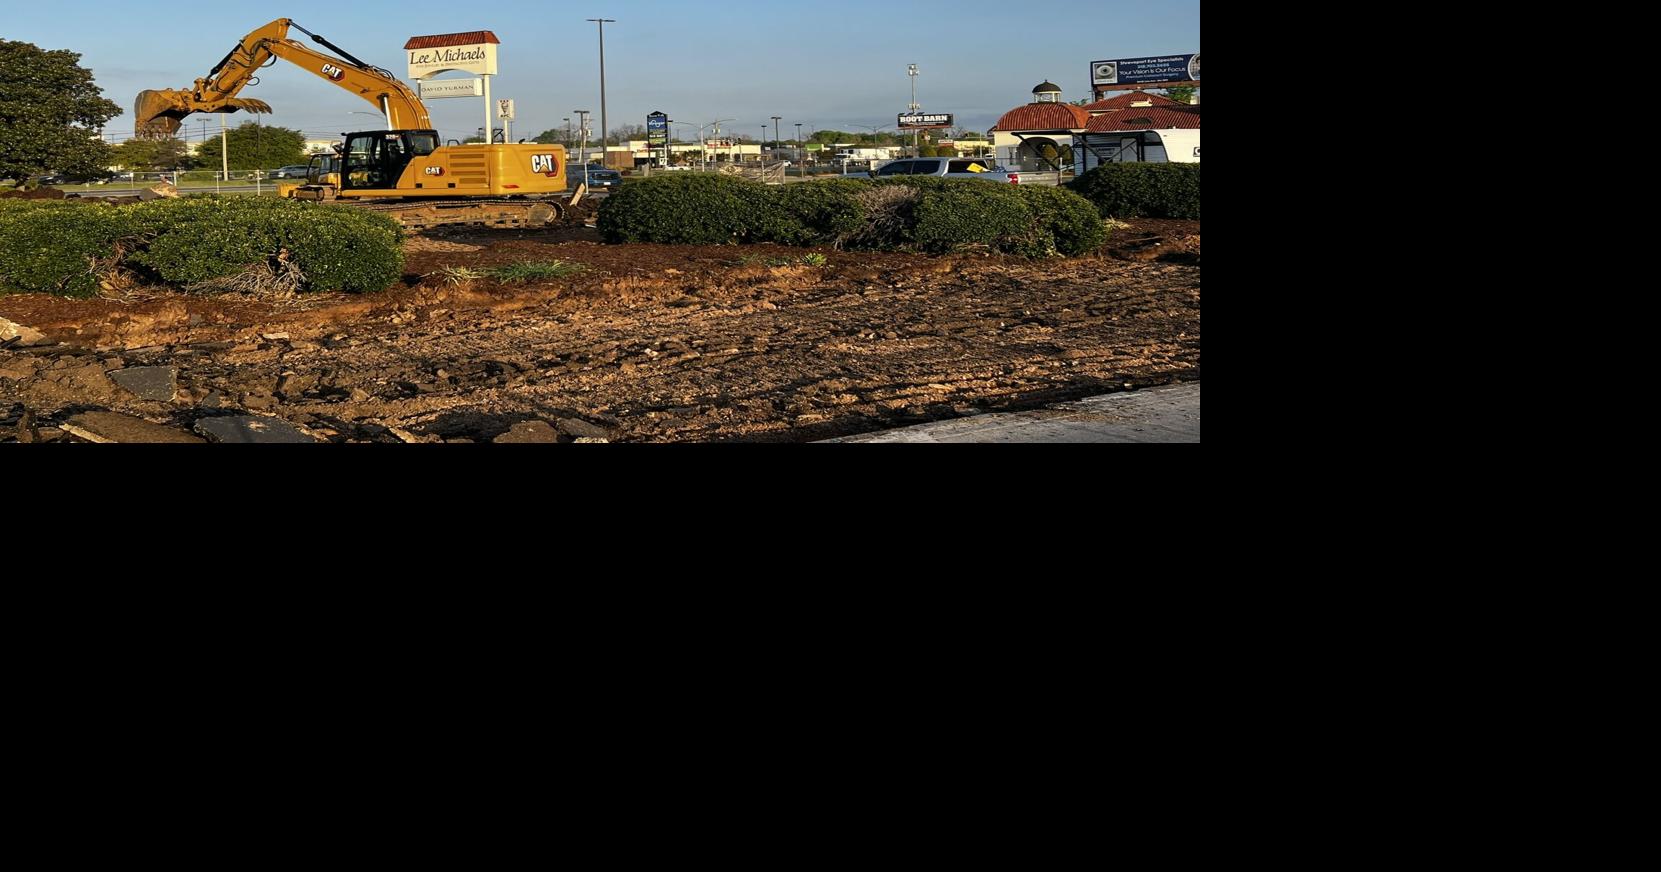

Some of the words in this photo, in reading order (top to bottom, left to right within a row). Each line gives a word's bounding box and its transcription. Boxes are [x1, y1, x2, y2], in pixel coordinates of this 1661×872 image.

[410, 52, 430, 65] Lee
[433, 47, 486, 62] Michaels
[321, 63, 342, 78] CAT
[531, 155, 553, 173] CAT
